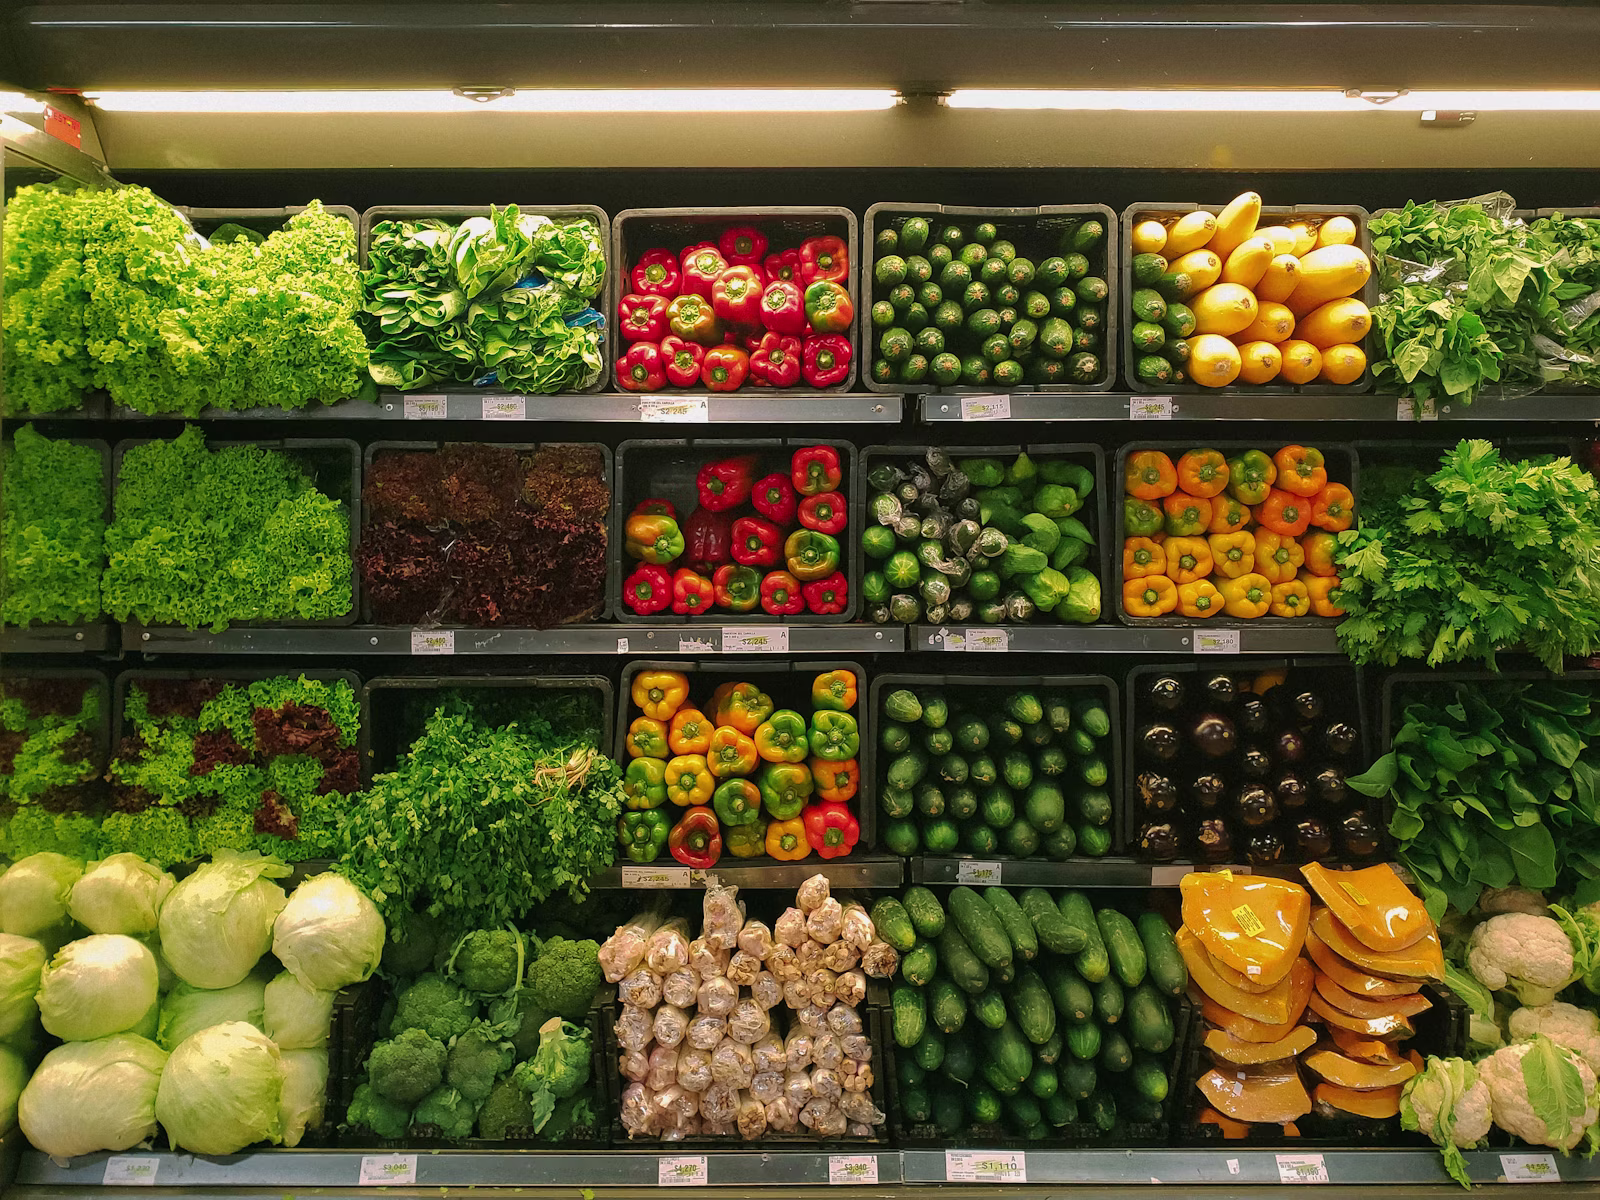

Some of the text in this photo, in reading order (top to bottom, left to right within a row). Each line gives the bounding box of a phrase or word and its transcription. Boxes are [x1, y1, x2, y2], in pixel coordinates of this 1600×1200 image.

[700, 401, 707, 409] A
[981, 403, 1004, 411] $2,115
[660, 407, 688, 415] $2,245
[781, 631, 787, 639] A
[742, 638, 768, 646] $2,245
[870, 1156, 876, 1164] A
[674, 1164, 697, 1173] $4,270
[844, 1163, 867, 1173] $3,340
[981, 1162, 1017, 1171] $1,110
